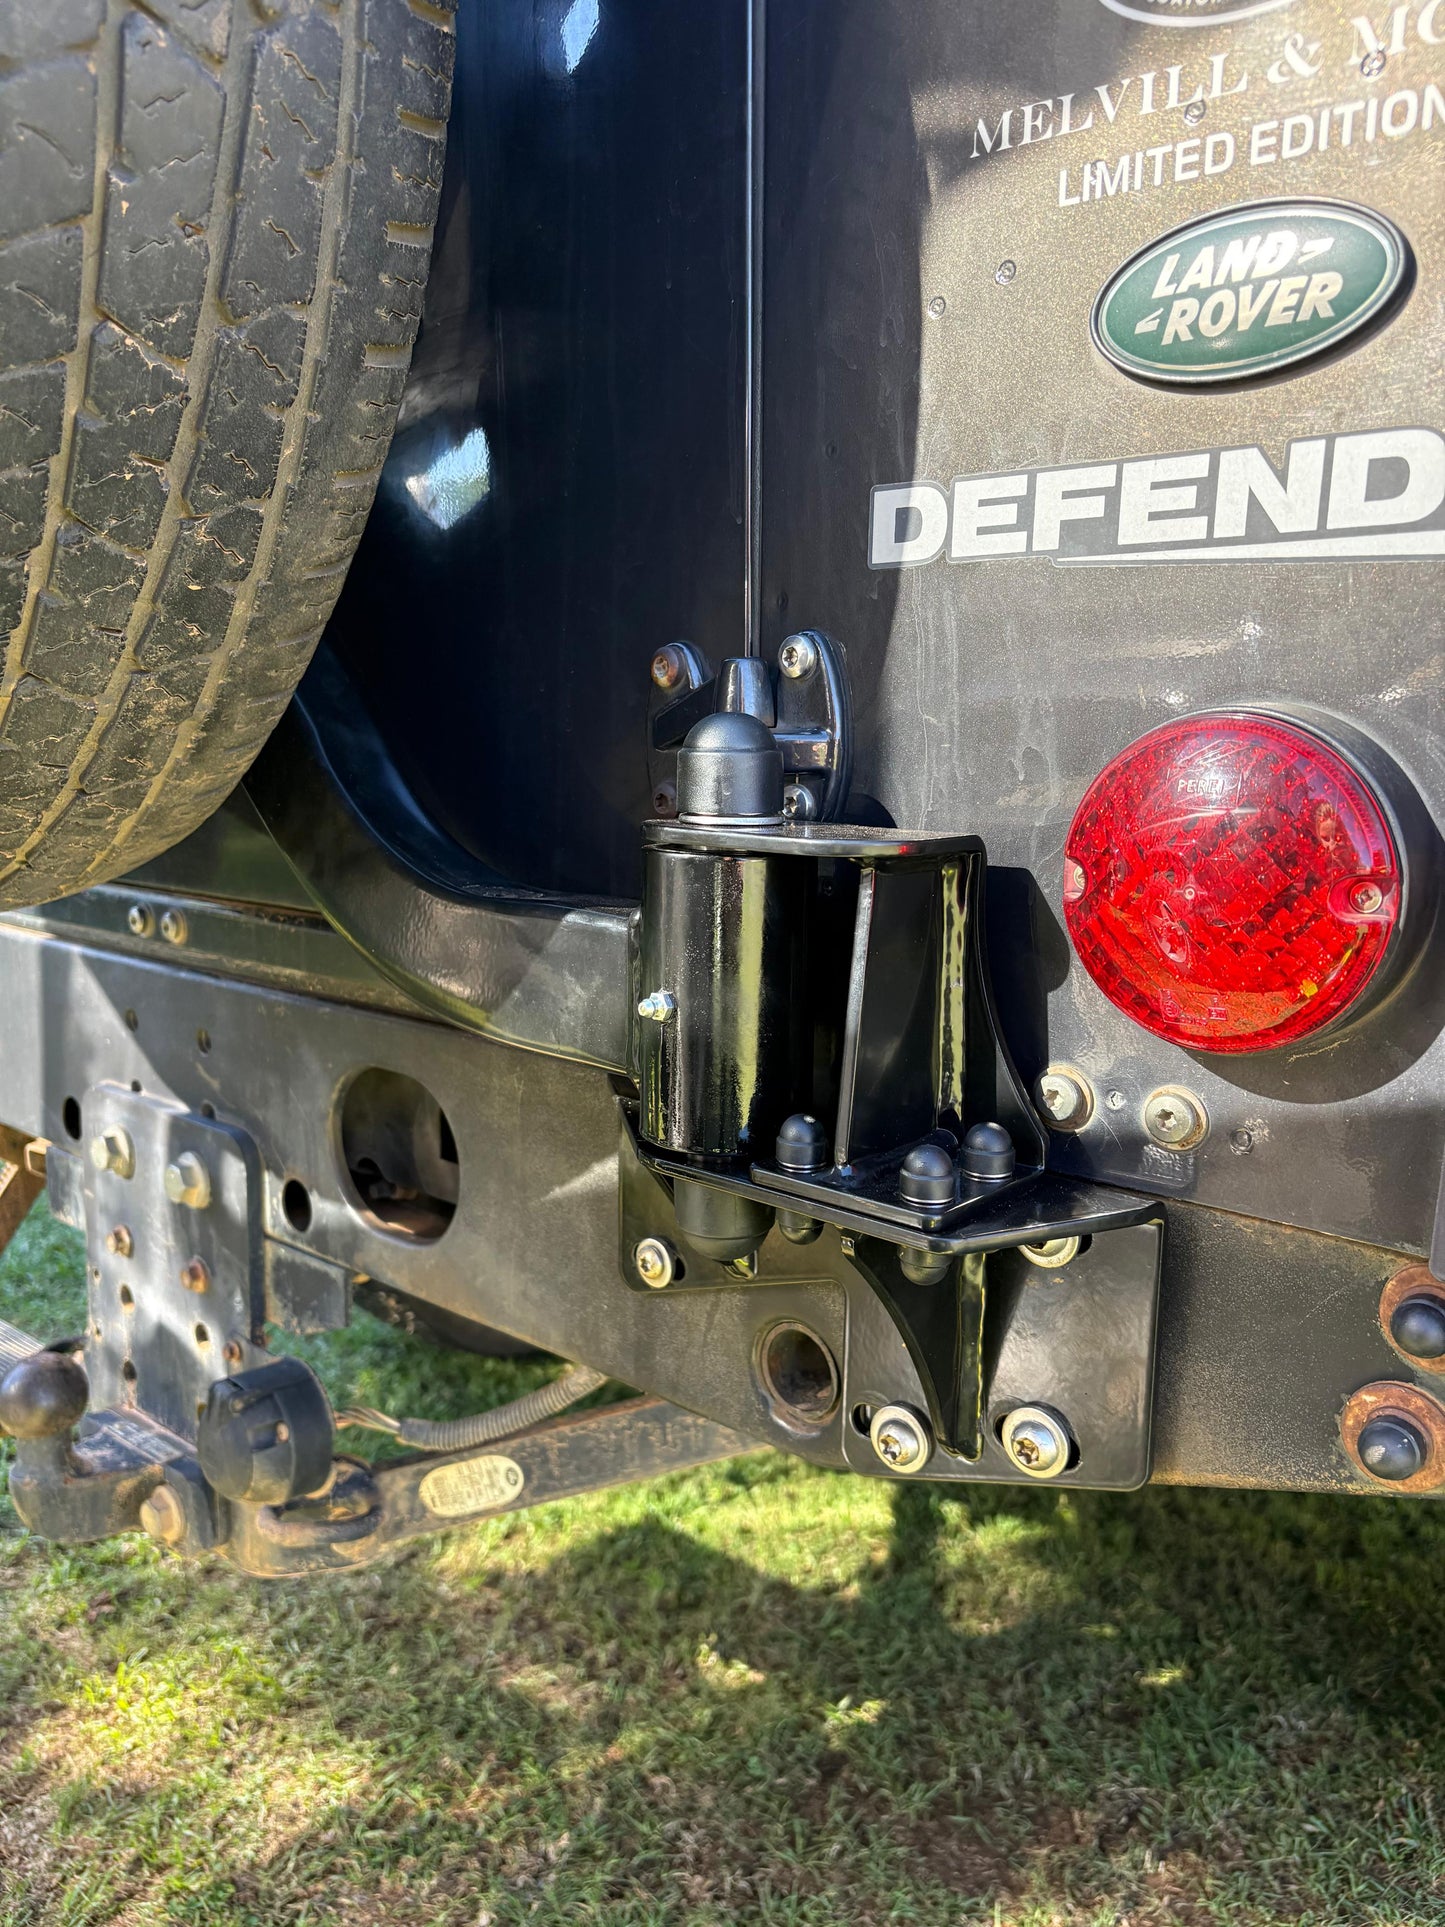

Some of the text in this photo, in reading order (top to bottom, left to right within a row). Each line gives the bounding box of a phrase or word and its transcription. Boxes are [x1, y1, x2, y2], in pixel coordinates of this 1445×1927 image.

[969, 52, 1248, 159] MELVILL
[1267, 32, 1325, 84] &
[1058, 84, 1445, 208] LIMITED EDITION
[1151, 229, 1298, 300] LAND
[1160, 271, 1344, 346] ROVER
[871, 429, 1445, 564] DEFEND
